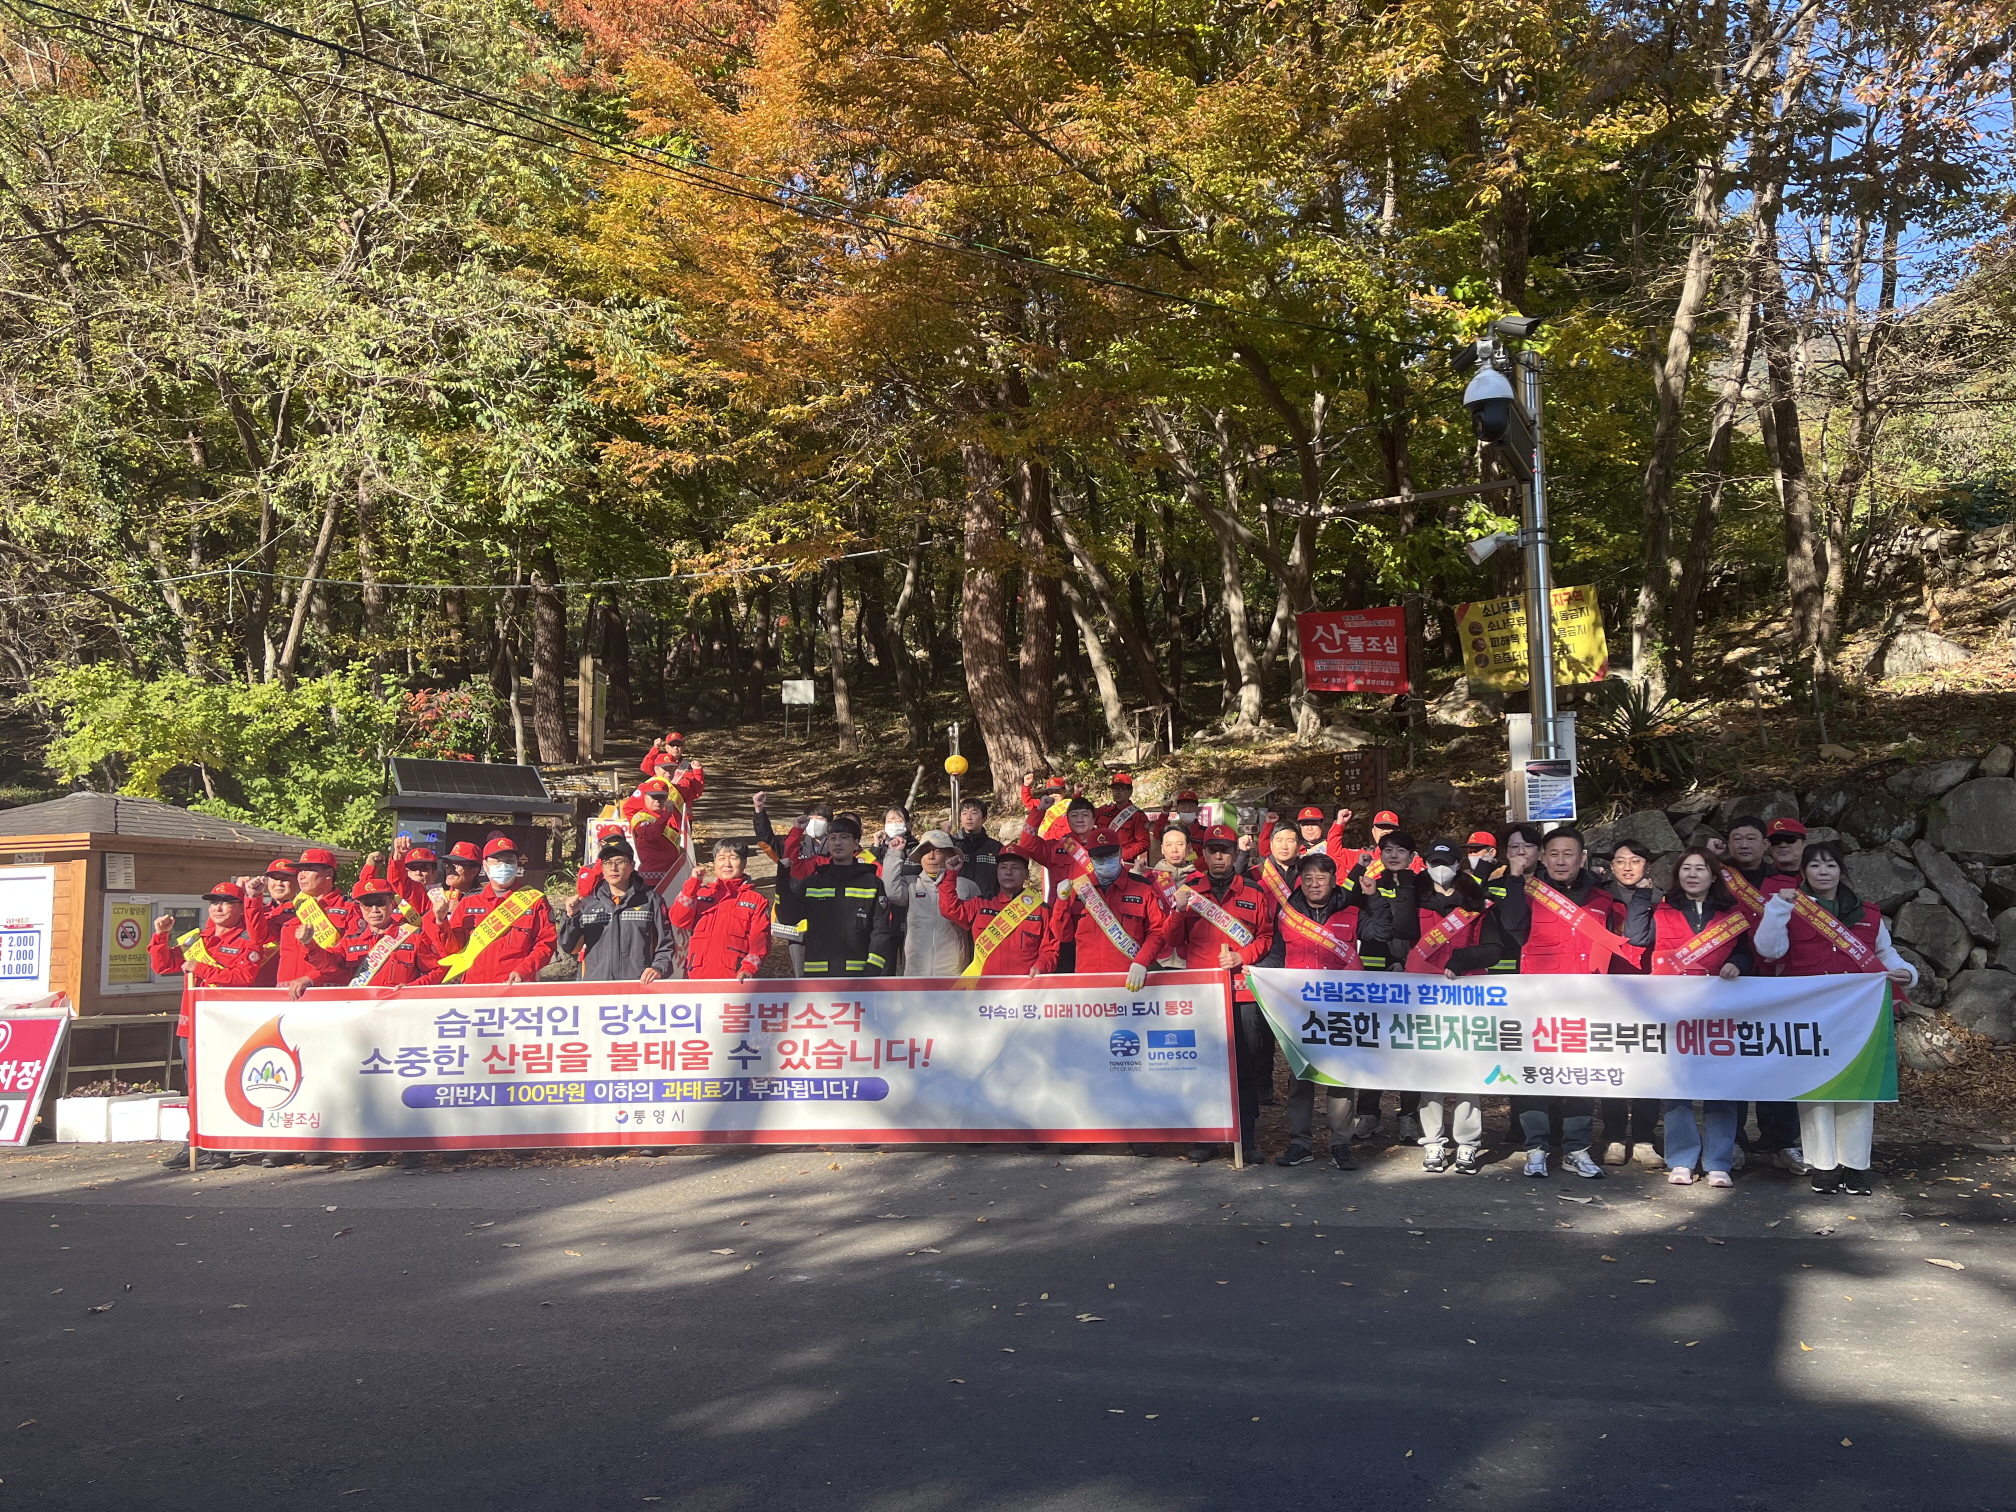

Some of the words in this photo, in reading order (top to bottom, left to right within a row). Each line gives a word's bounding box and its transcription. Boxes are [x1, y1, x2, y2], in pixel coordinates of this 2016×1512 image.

[1482, 600, 1521, 617] 소나무류
[1551, 589, 1585, 607] 지구역
[1488, 617, 1527, 632] 소나무류
[1311, 623, 1398, 654] 산불조심
[1490, 633, 1520, 648] 피해목
[1556, 624, 1587, 639] 용금지
[515, 891, 532, 906] ZERO
[130, 907, 146, 915] 촬영중
[305, 911, 322, 925] ZERO
[498, 906, 515, 922] ZERO
[1004, 908, 1020, 923] ZERO
[1010, 902, 1028, 918] 소각
[1091, 901, 1114, 927] 한순간
[1205, 905, 1232, 928] 한순간
[480, 922, 497, 939] ZERO
[486, 914, 506, 932] 산불
[993, 915, 1013, 935] 불씨
[8, 935, 34, 947] 2,000
[317, 926, 335, 944] ZERO
[988, 925, 1005, 941] ZERO
[1430, 928, 1448, 945] 산불
[977, 933, 996, 952] 산불
[8, 949, 34, 961] 7,000
[128, 953, 147, 961] 주차금지
[1301, 981, 1411, 1004] 산림조합과
[1416, 983, 1508, 1007] 함께해요
[979, 1005, 1019, 1020] 약속의
[1023, 1004, 1042, 1020] 땅,
[1043, 1001, 1128, 1019] 미래100년의
[1131, 1000, 1160, 1017] 도시
[1164, 1000, 1194, 1016] 통영
[434, 1005, 579, 1038] 습관적인
[598, 1003, 703, 1034] 당신의
[718, 1001, 866, 1033] 불법소각
[1302, 1012, 1381, 1048] 소중한
[1388, 1015, 1525, 1053] 산림자원을
[1531, 1016, 1666, 1056] 산불로부터
[1675, 1016, 1831, 1058] 예방합시다.
[359, 1044, 469, 1076] 소중한
[481, 1041, 592, 1074] 산림을
[606, 1039, 713, 1073] 불태울
[727, 1041, 762, 1070] 수
[777, 1037, 934, 1071] 있습니다!
[1148, 1050, 1198, 1060] unesco
[1521, 1065, 1625, 1087] 통영산림조합
[434, 1084, 496, 1105] 위반시
[507, 1082, 586, 1103] 100만원
[594, 1080, 653, 1102] 이하의
[662, 1079, 742, 1101] 과태료가
[748, 1078, 859, 1100] 부과됩니다!
[267, 1110, 321, 1129] 산불조심
[633, 1108, 686, 1125] 통영시
